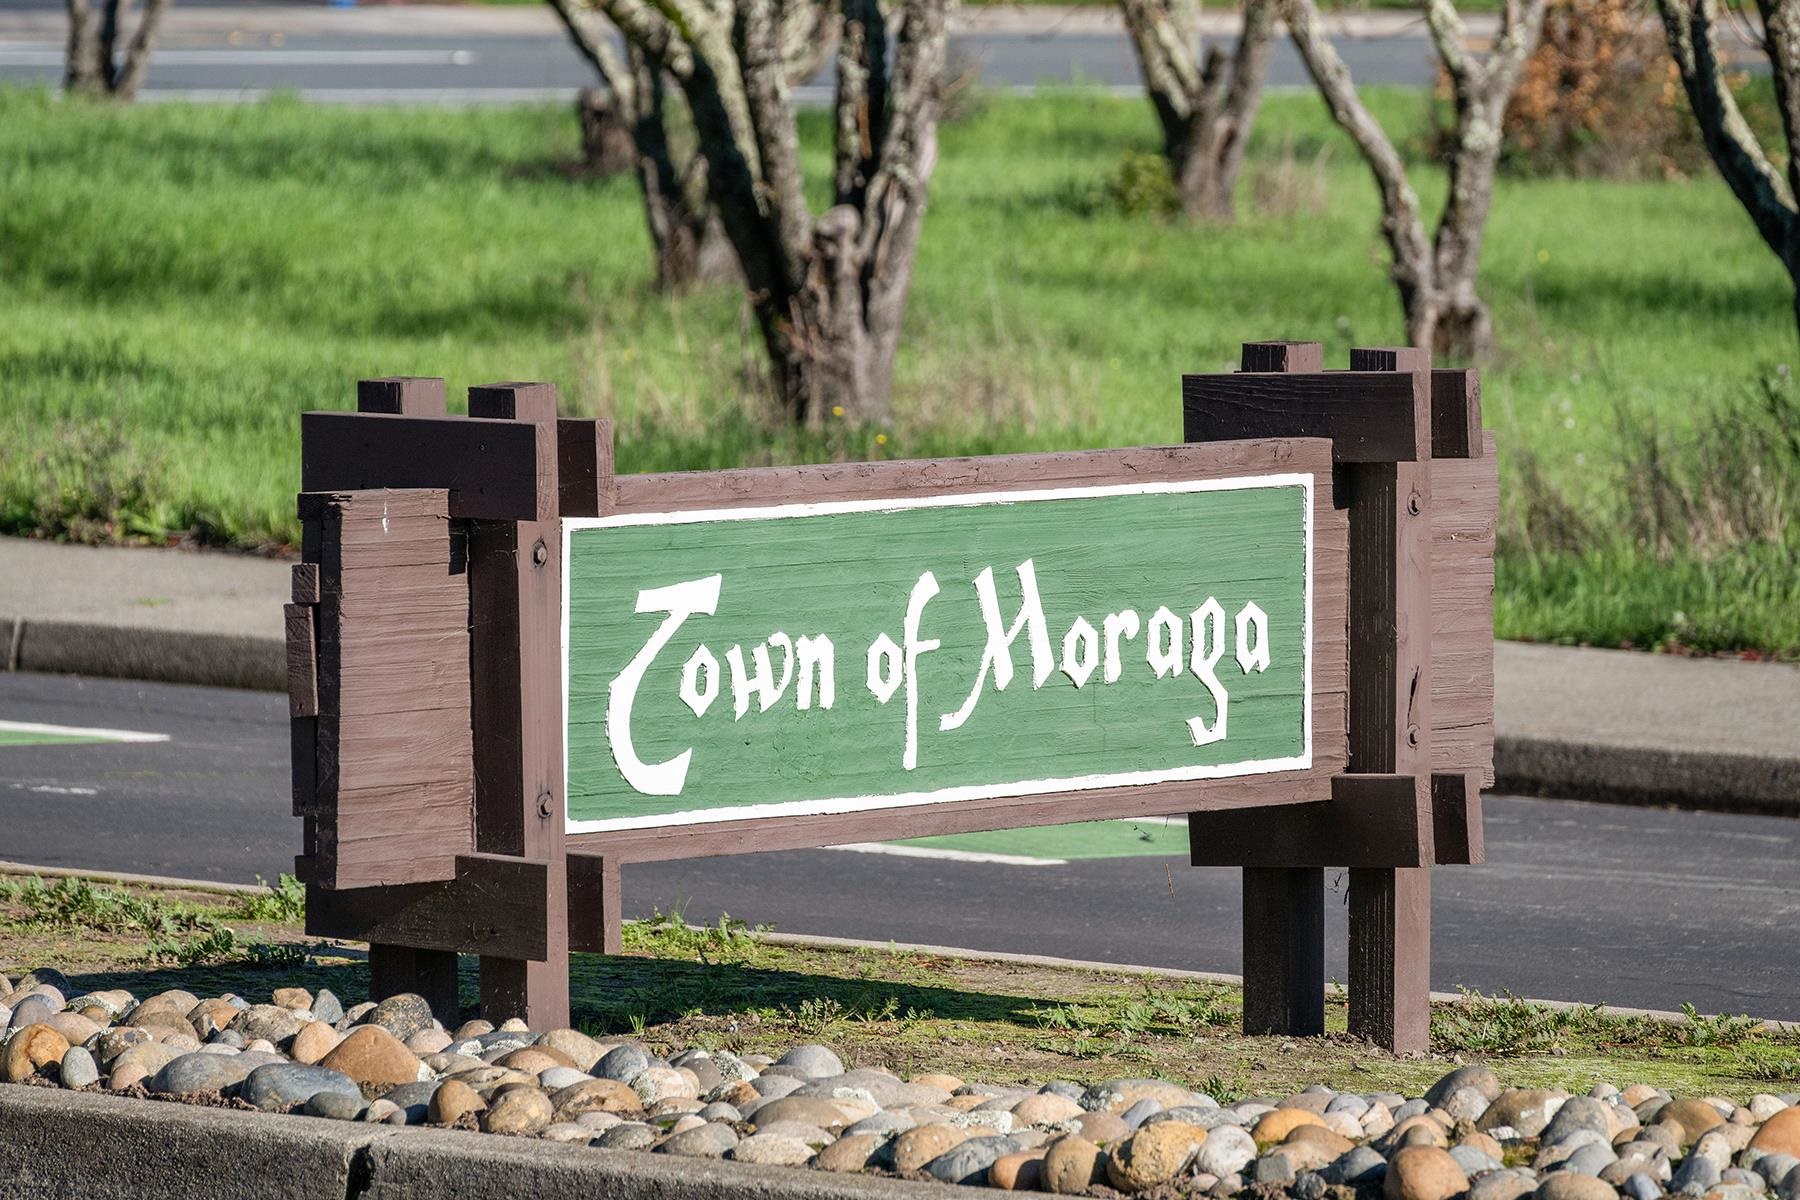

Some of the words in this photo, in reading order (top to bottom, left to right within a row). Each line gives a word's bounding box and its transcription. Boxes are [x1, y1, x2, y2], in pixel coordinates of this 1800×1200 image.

[605, 573, 835, 796] Town
[866, 570, 941, 771] of
[939, 558, 1270, 746] Moraga
